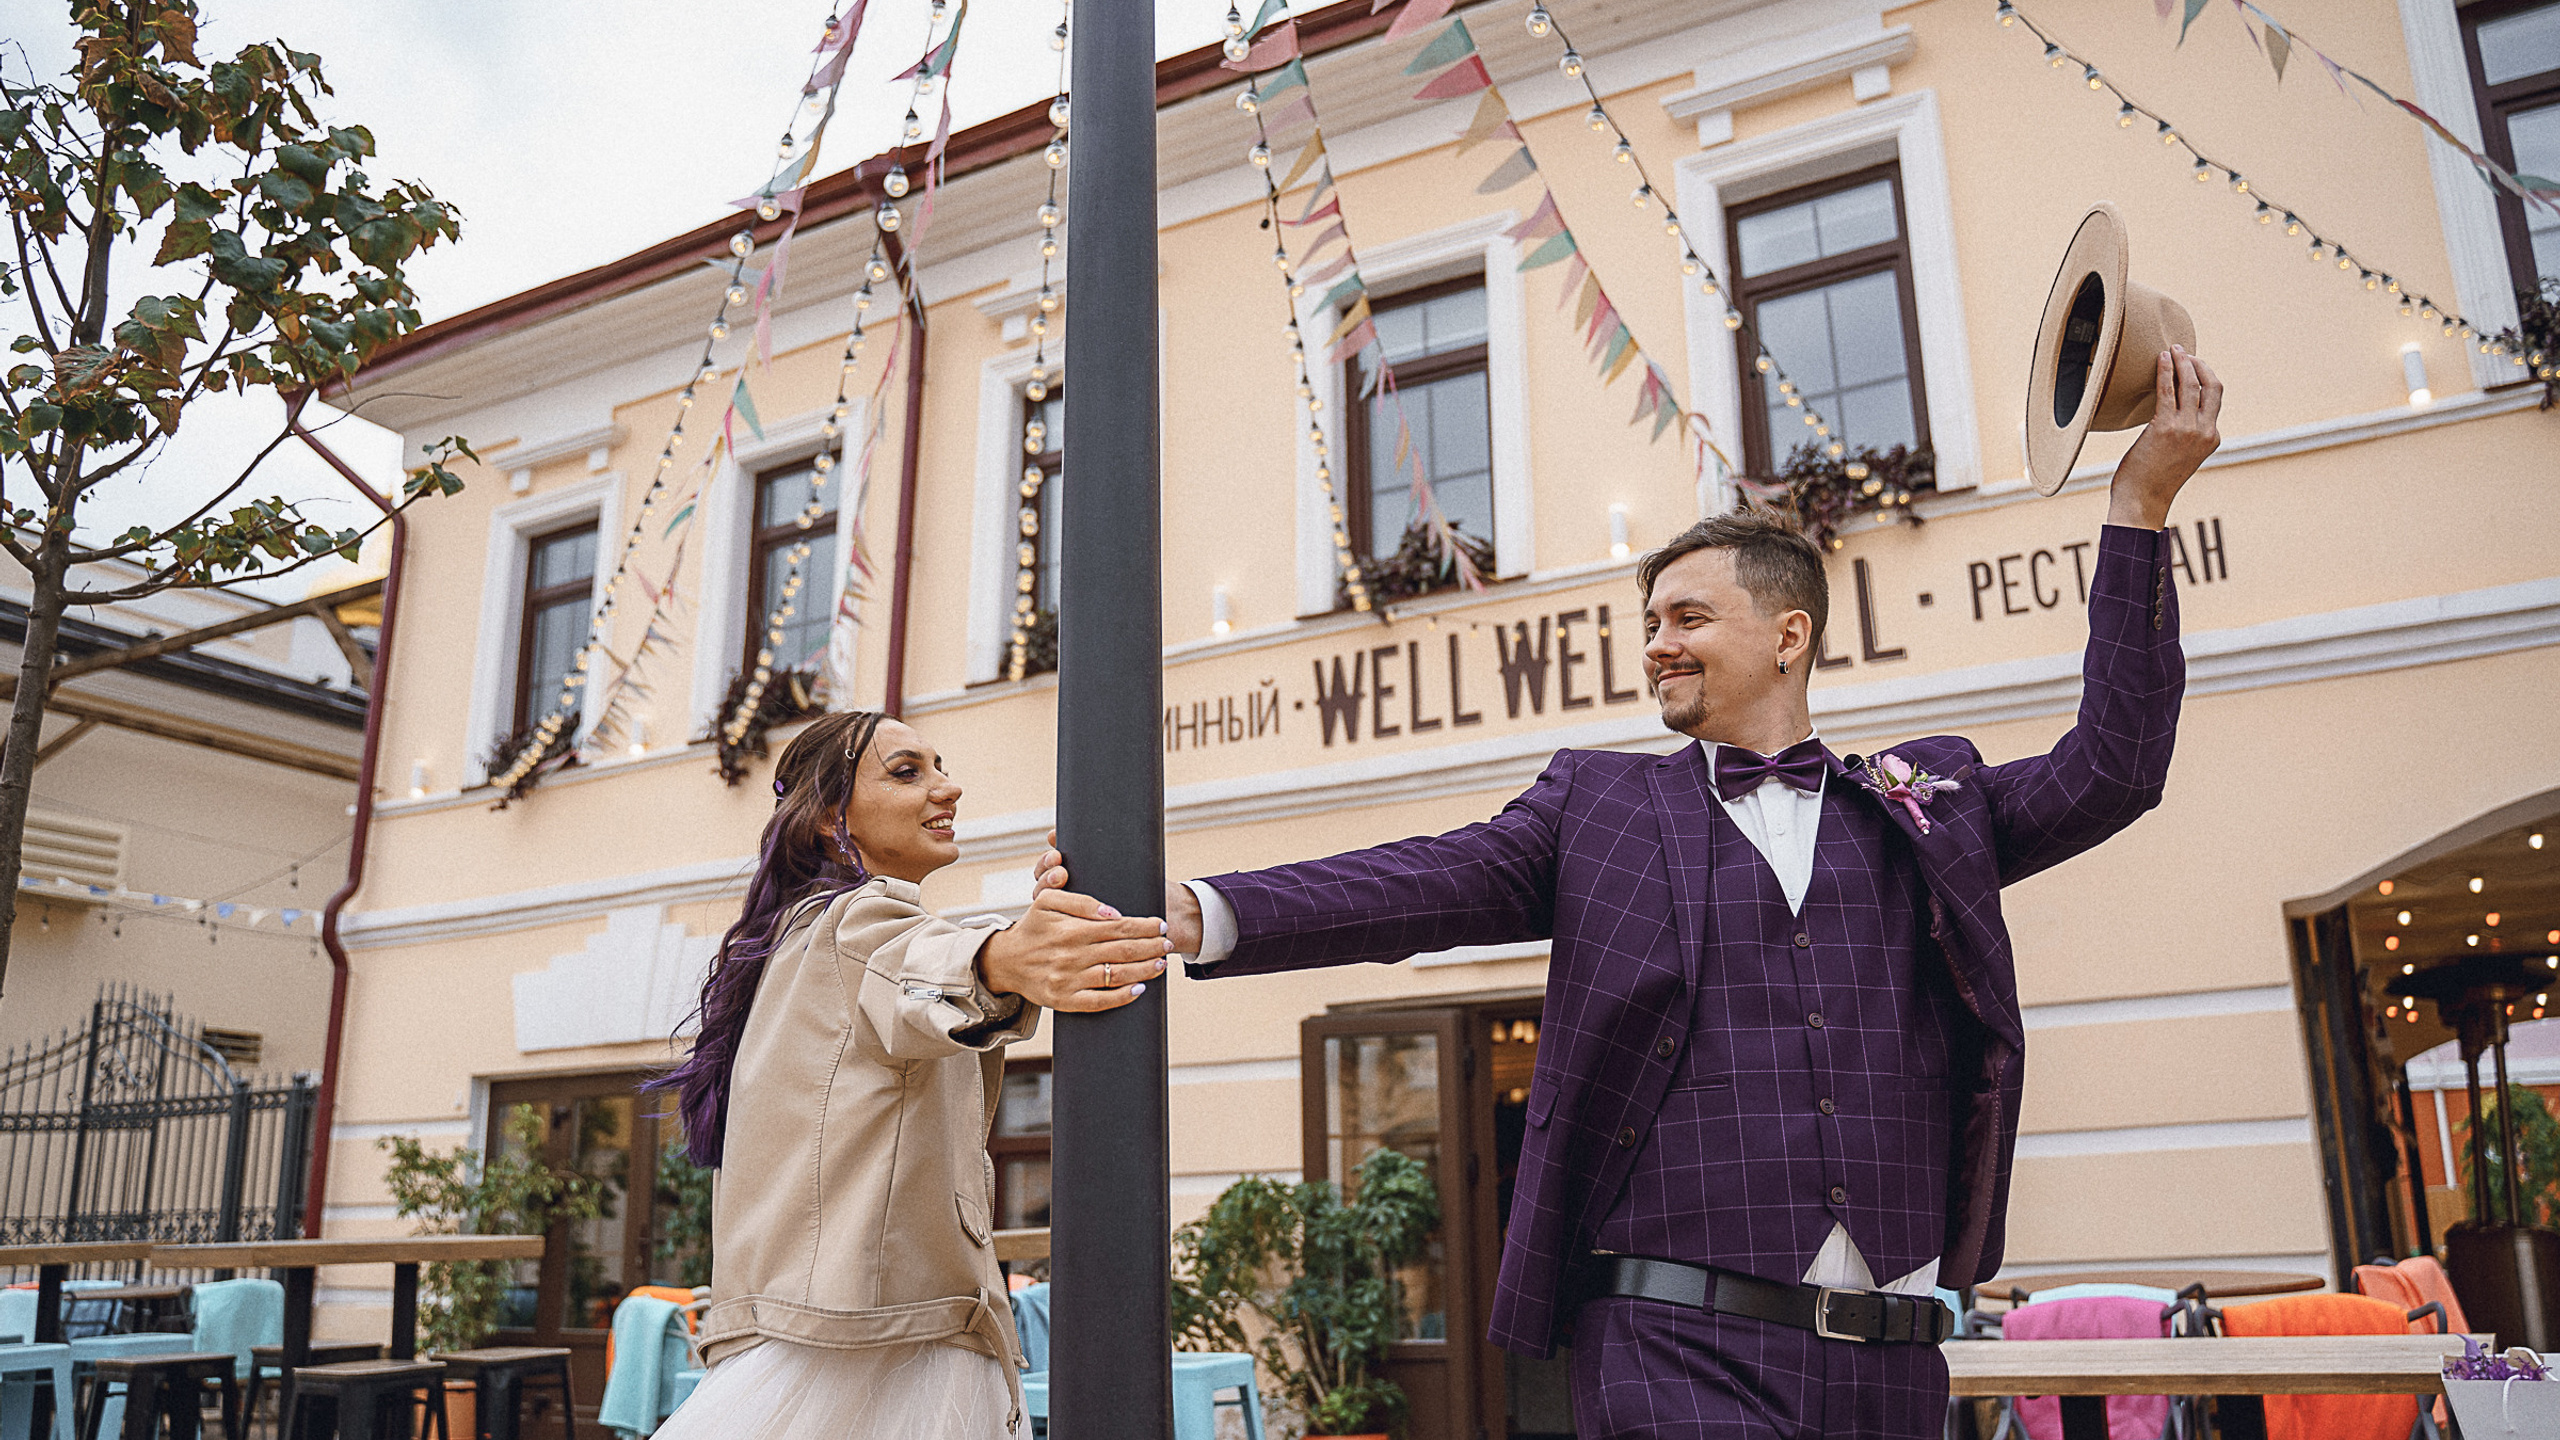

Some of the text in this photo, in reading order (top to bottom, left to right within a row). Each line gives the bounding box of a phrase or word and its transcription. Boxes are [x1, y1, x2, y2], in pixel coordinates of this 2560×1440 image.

[1315, 633, 1483, 748] WELL
[1496, 604, 1657, 720] WEL
[1968, 517, 2228, 622] РЕСТАН
